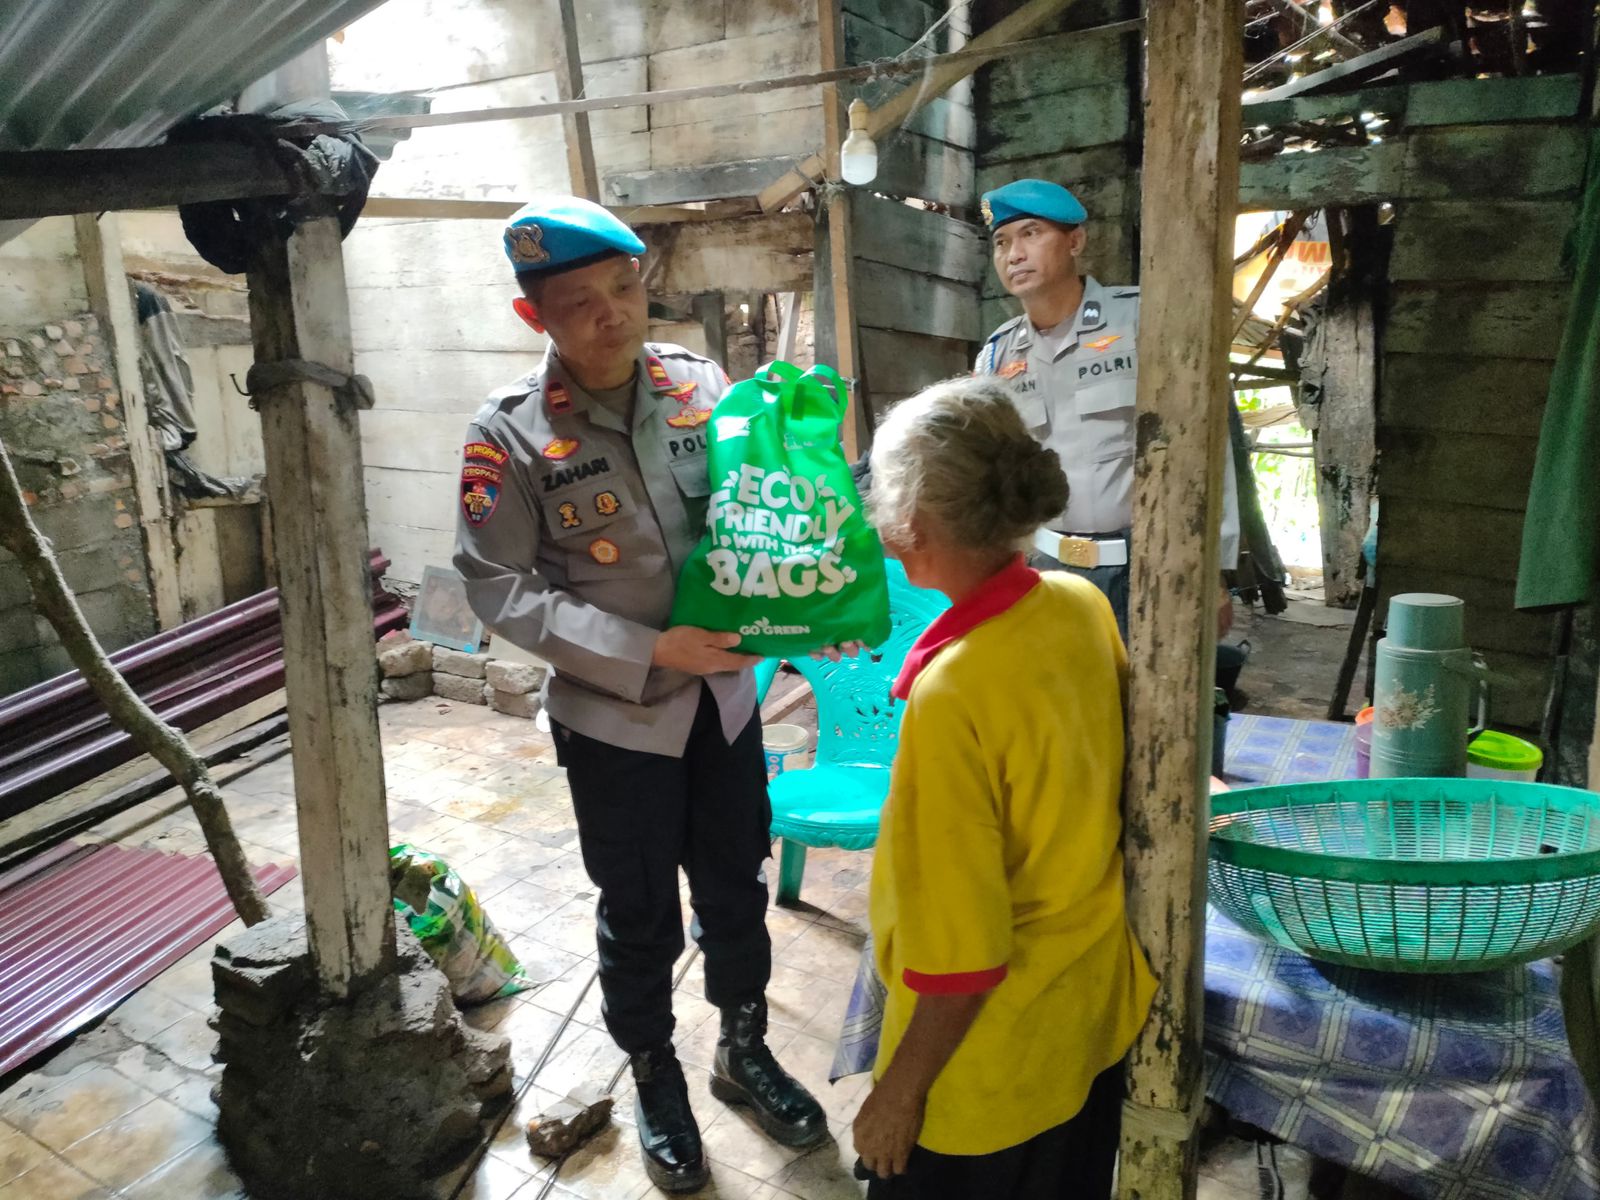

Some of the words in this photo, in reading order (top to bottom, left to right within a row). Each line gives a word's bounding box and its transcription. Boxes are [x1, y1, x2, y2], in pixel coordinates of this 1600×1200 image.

[1078, 356, 1132, 379] POLRI
[541, 457, 610, 492] ZAHARI
[737, 463, 815, 512] ECO
[733, 532, 779, 552] WITH
[781, 542, 815, 556] THE
[706, 548, 846, 599] BAGS
[739, 625, 761, 636] GO
[763, 624, 811, 636] GREEN
